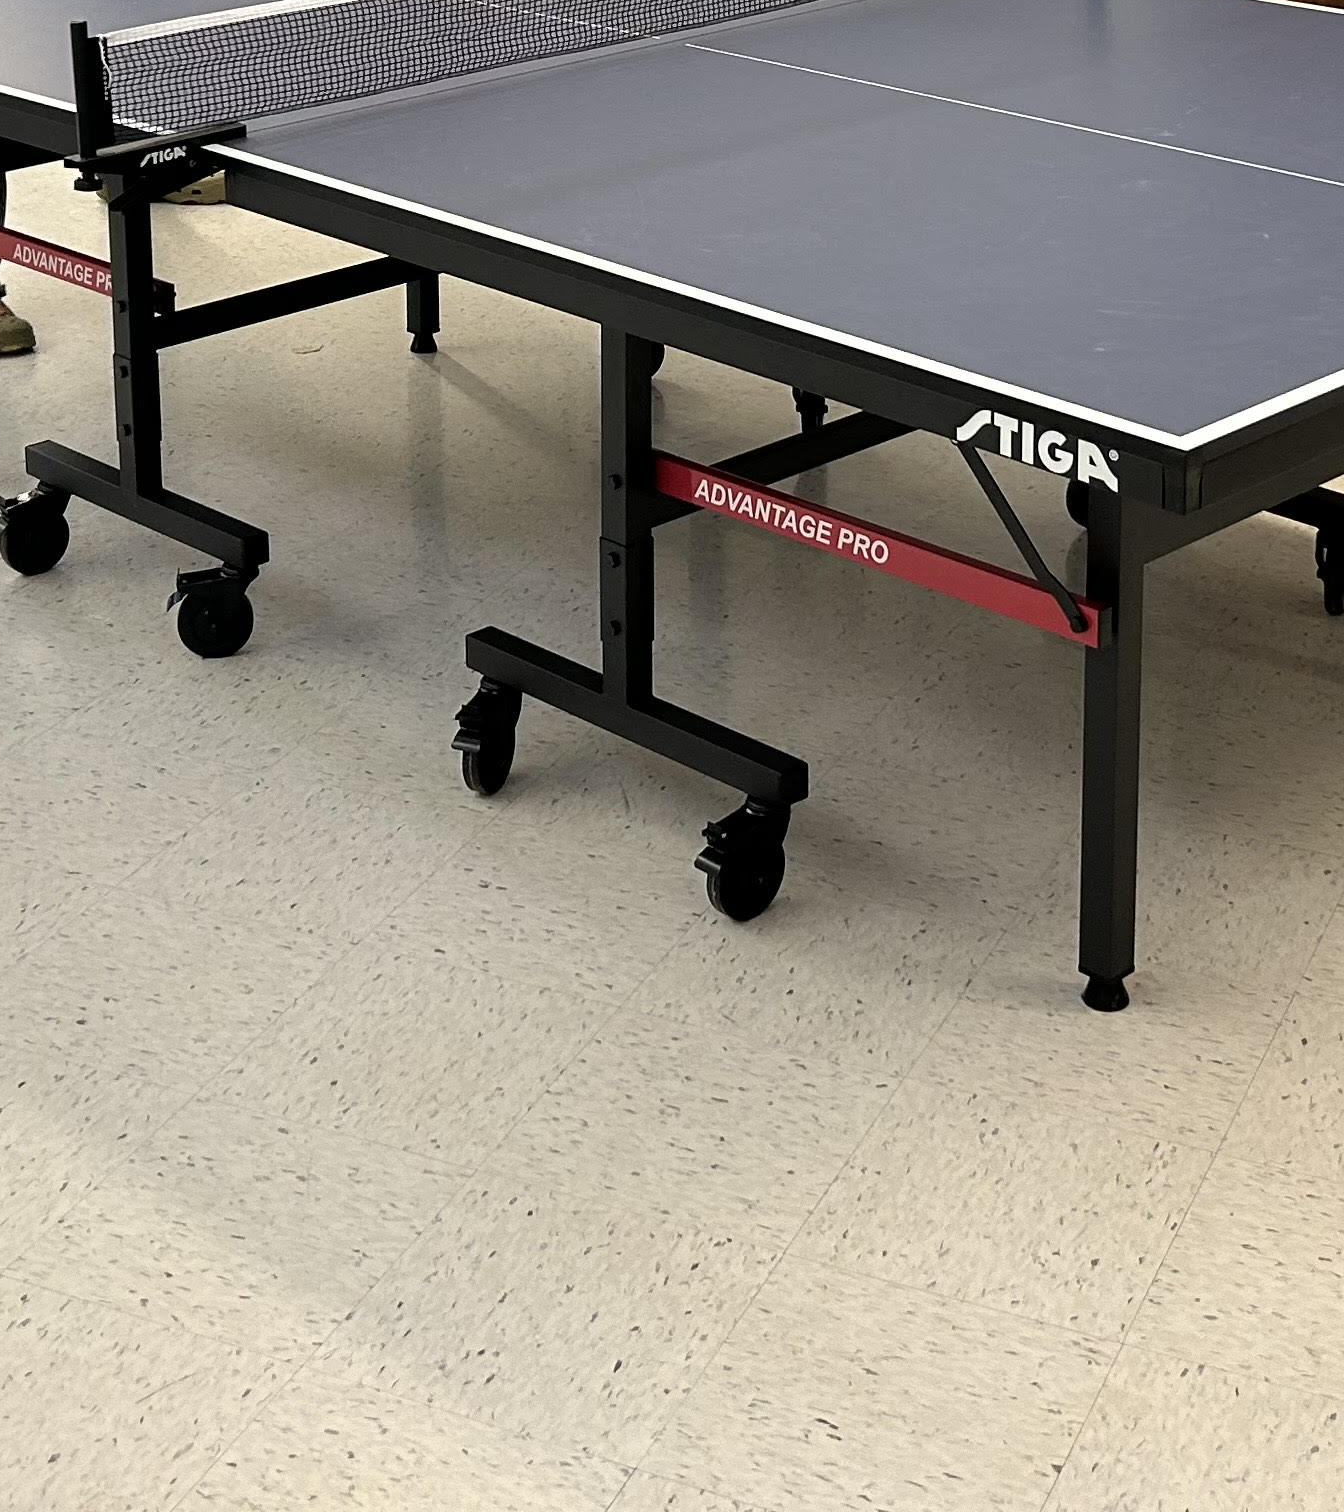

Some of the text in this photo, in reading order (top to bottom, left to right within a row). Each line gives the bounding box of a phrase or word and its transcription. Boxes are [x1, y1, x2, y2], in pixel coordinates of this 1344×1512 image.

[139, 145, 187, 168] STIGA
[13, 243, 113, 291] ADVANTAGE PR
[956, 409, 1120, 493] STIGA
[694, 478, 890, 564] ADVANTAGE PRO
